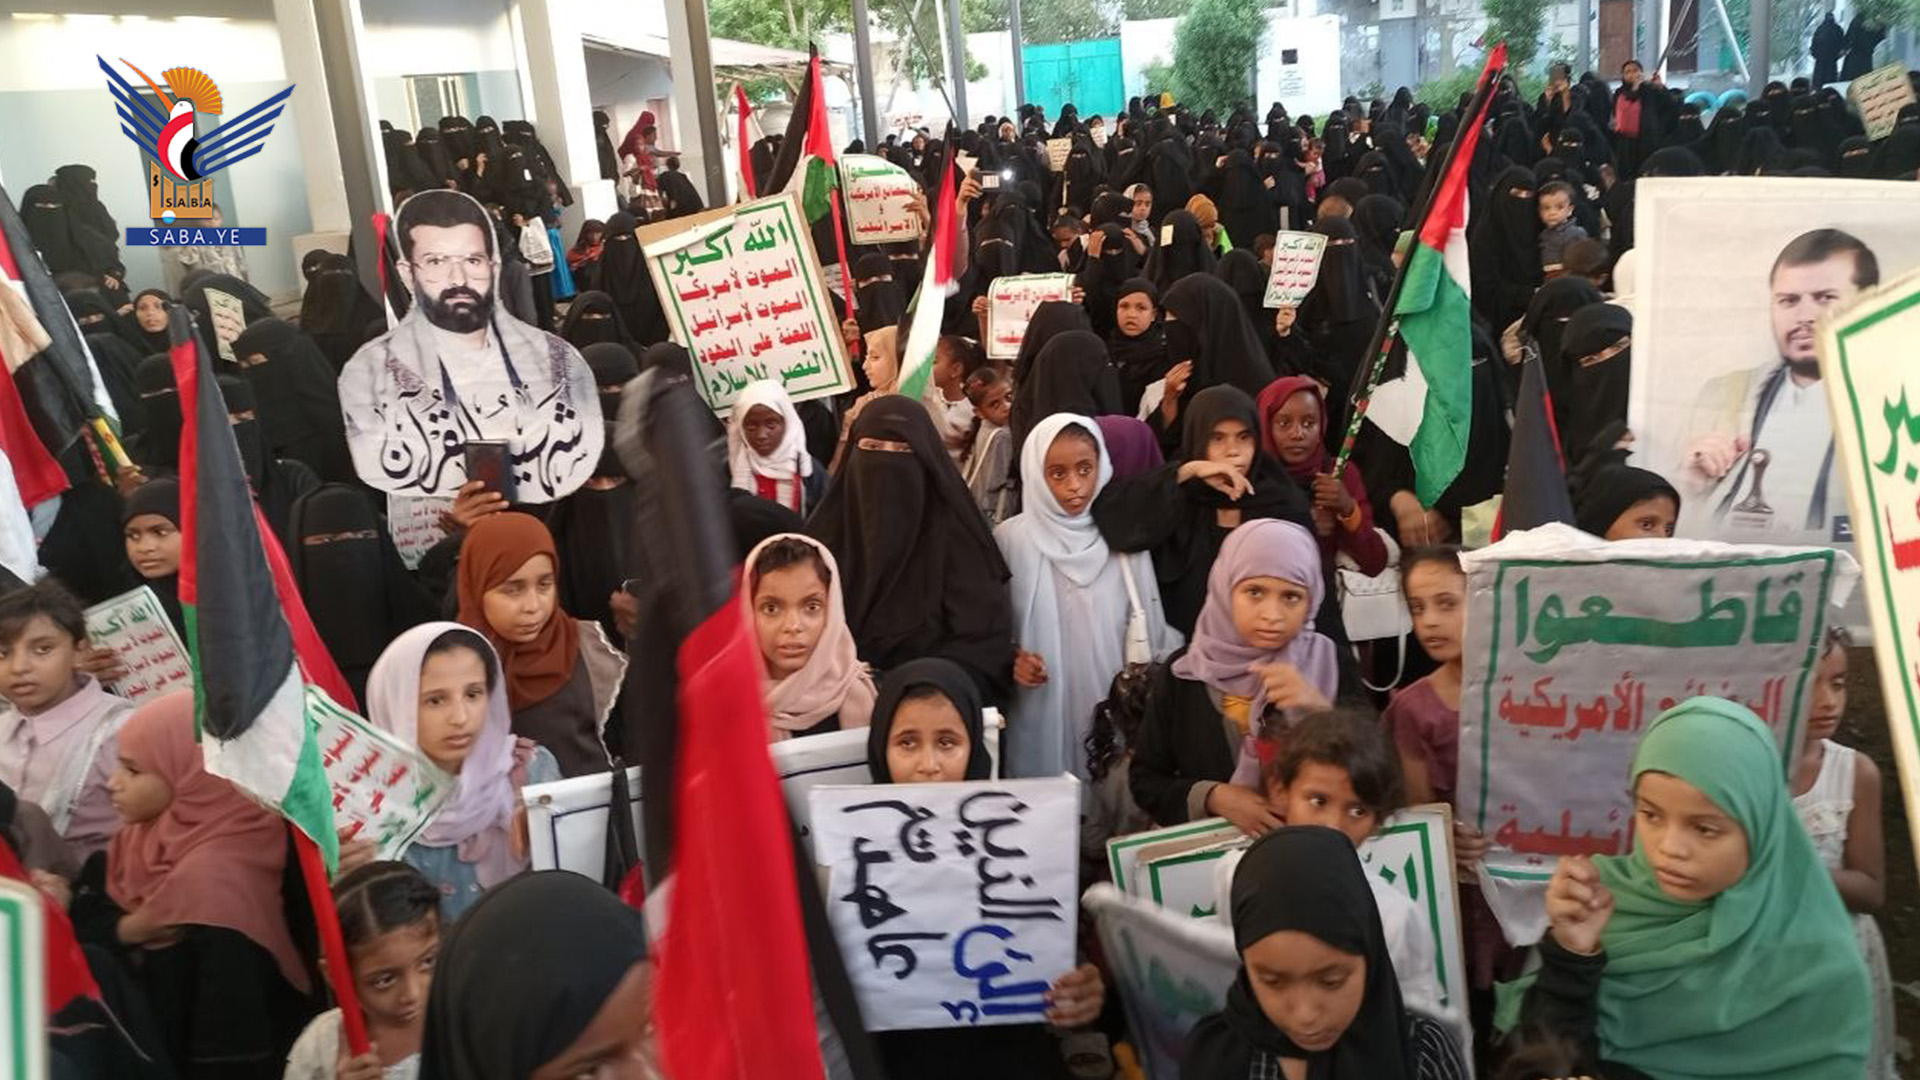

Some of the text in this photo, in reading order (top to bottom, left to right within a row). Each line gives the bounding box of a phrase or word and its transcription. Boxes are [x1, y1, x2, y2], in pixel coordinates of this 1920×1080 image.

[744, 218, 789, 252] الله
[746, 257, 800, 289] الموت
[756, 290, 809, 321] الموت
[699, 320, 819, 366] اللعنة على اليهود
[779, 349, 829, 387] النصر
[1514, 571, 1805, 664] قاطعوا
[1498, 671, 1645, 741] الأمريكية
[951, 790, 1064, 922] الذين
